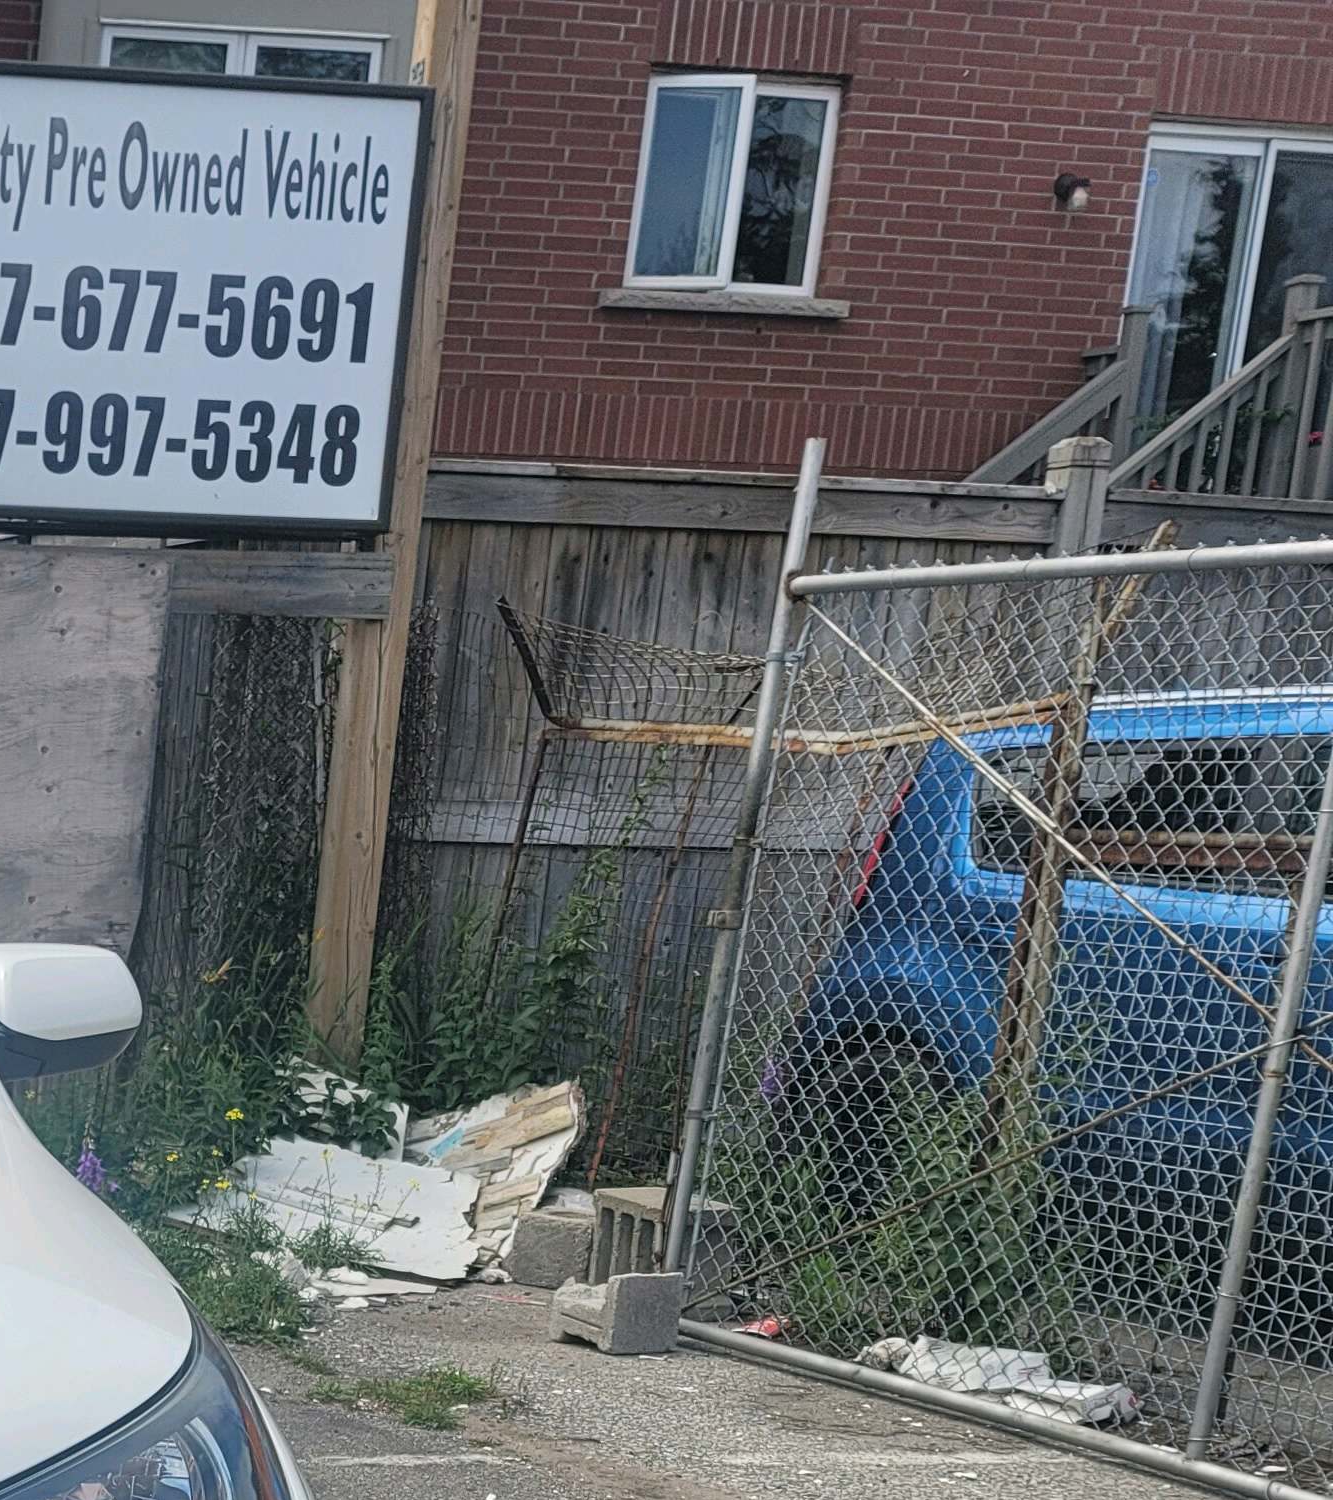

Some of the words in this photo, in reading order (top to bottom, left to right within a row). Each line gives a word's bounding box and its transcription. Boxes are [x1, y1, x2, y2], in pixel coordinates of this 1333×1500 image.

[44, 116, 107, 209] Pre
[118, 120, 250, 218] Owned
[263, 128, 390, 226] Vehicle
